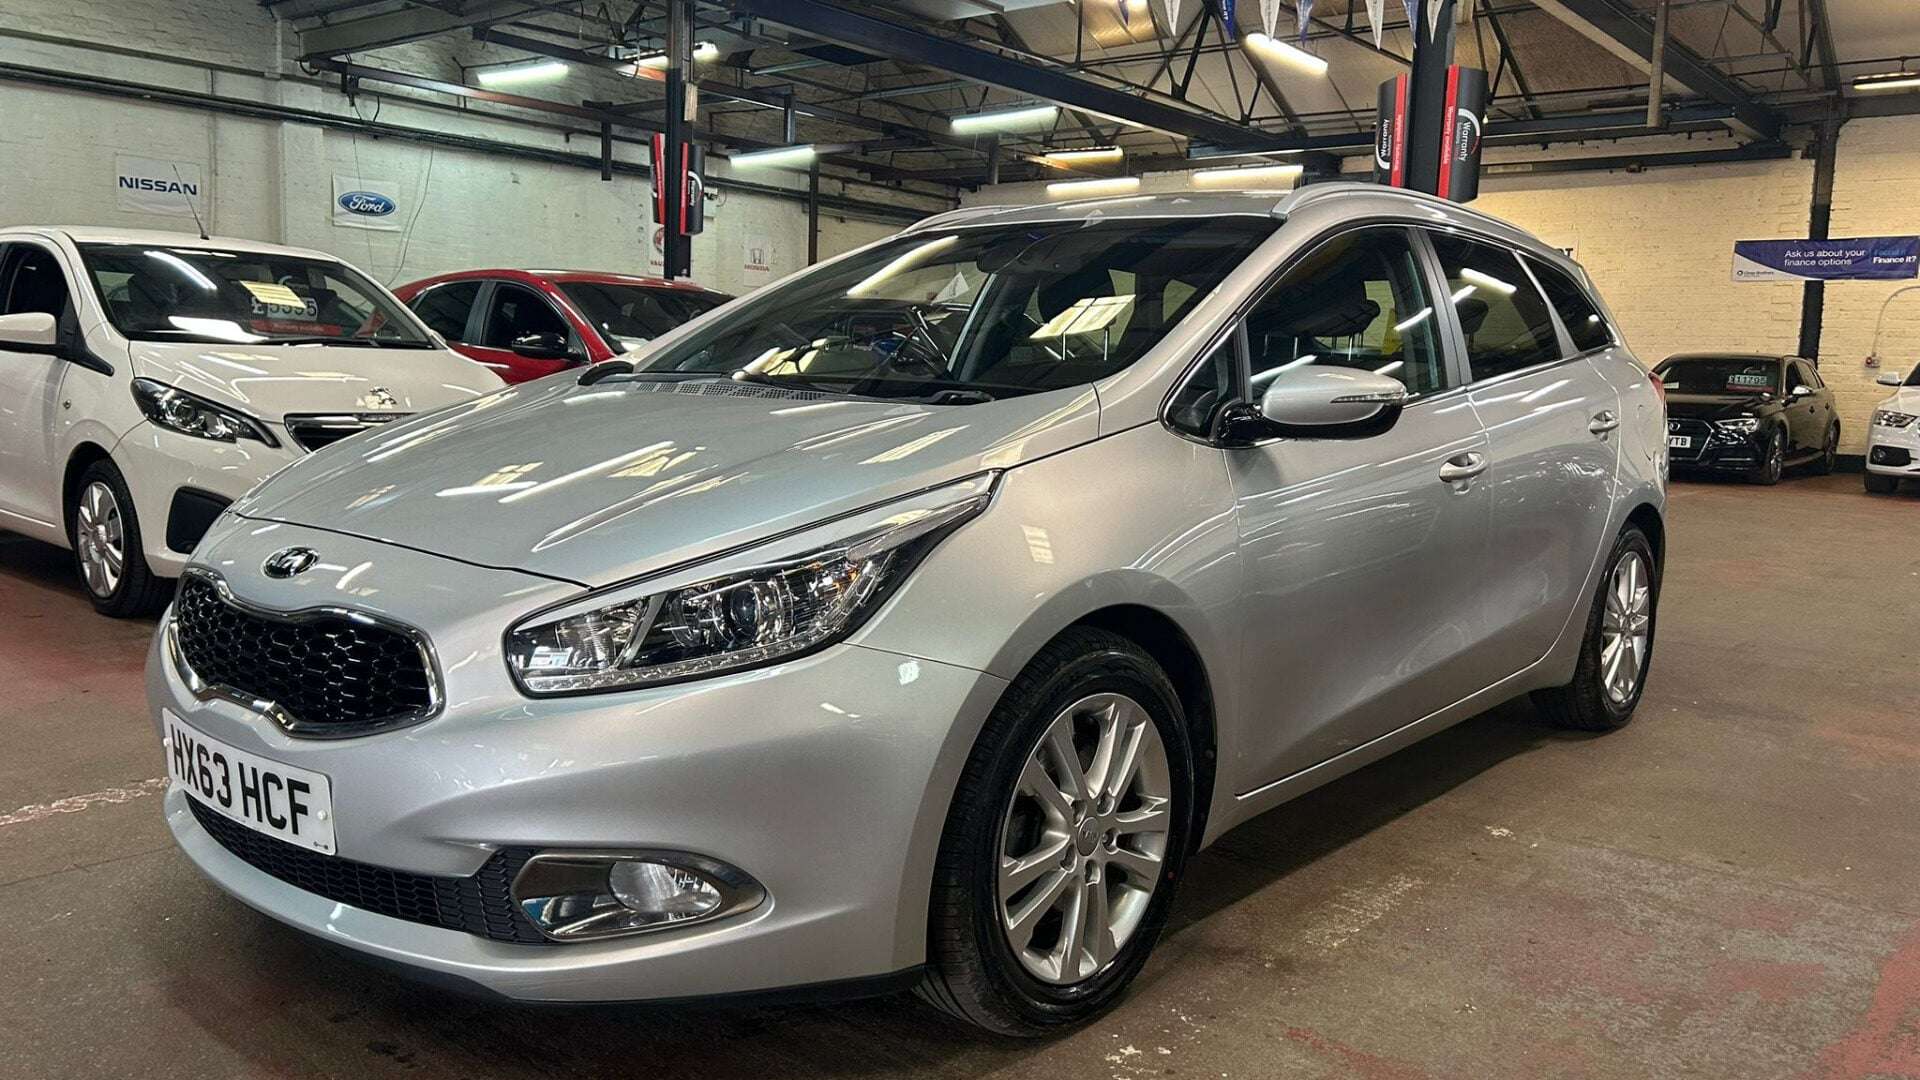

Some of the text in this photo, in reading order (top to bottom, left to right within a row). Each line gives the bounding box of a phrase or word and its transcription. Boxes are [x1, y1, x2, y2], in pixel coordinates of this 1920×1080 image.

[1380, 118, 1390, 158] Warranty
[1458, 121, 1471, 162] Warranty
[118, 176, 198, 195] NISSAN
[350, 195, 386, 213] Ford
[1784, 258, 1852, 267] finance options
[1785, 250, 1801, 258] Ask
[1817, 249, 1843, 257] about
[1845, 250, 1866, 259] your
[1873, 255, 1917, 264] Finance it?
[744, 263, 770, 272] HONDA
[170, 723, 311, 836] HX63 HCF
